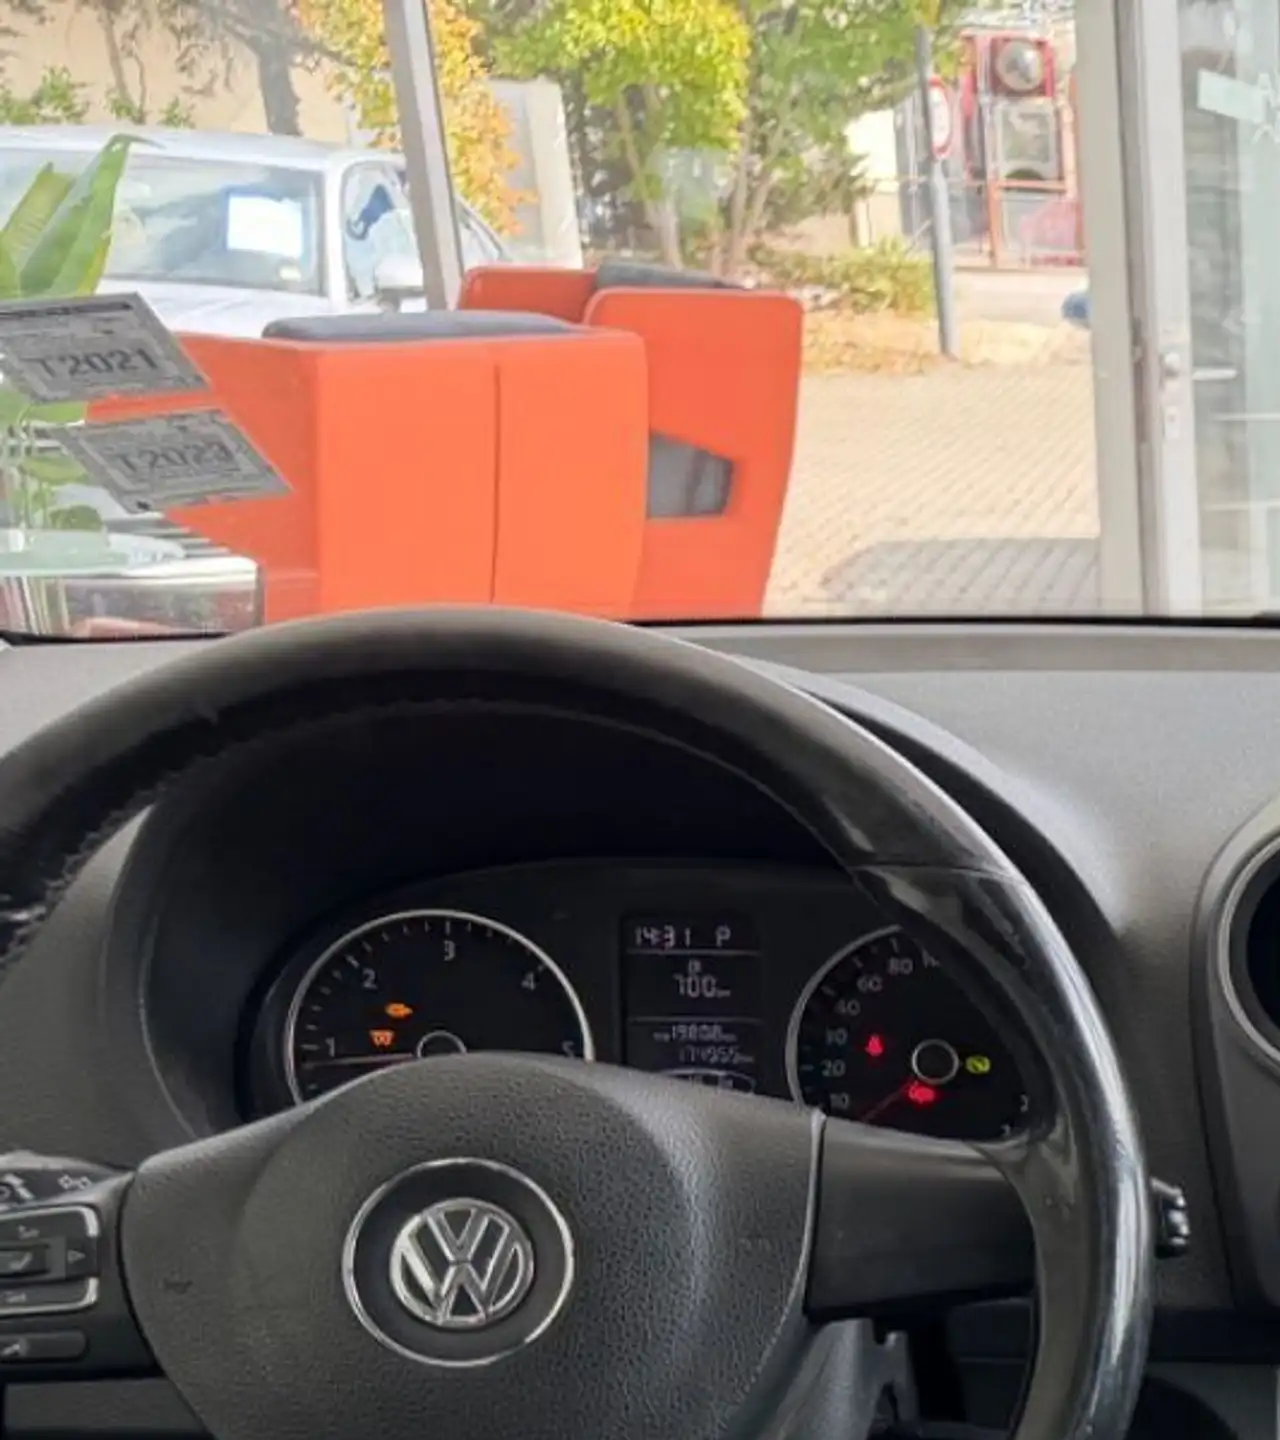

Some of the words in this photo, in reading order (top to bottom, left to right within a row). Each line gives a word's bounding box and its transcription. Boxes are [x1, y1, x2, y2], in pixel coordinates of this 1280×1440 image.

[715, 924, 732, 948] P
[443, 940, 456, 961] 3
[363, 968, 377, 988] 2
[521, 972, 537, 991] 4
[672, 973, 717, 998] 700
[325, 1037, 336, 1057] 1
[821, 1059, 846, 1077] 20
